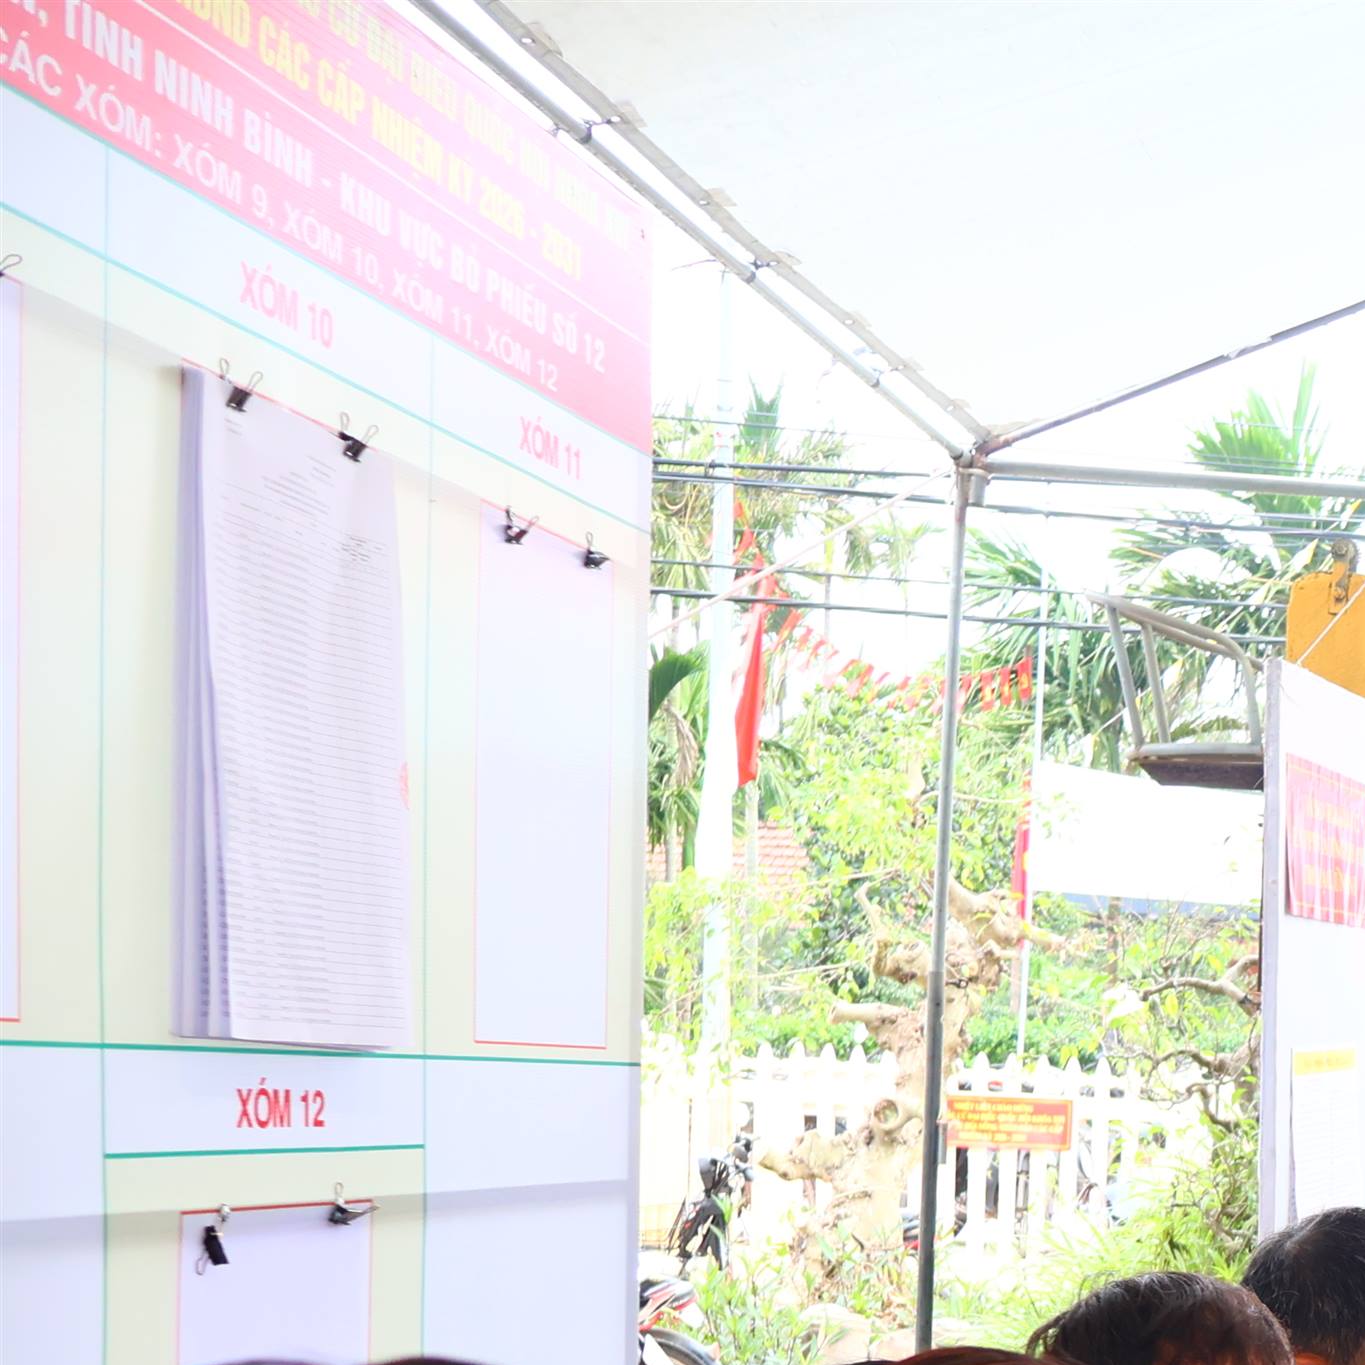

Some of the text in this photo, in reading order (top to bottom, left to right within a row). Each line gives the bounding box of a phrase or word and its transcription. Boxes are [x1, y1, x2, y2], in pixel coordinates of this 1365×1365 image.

[258, 15, 310, 91] CÁC
[317, 57, 365, 125] CẤP
[74, 73, 163, 159] XÓM:
[172, 133, 241, 205] XÓM
[252, 183, 274, 228] 9,
[282, 200, 343, 265] XÓM
[392, 267, 444, 324] XÓM
[485, 323, 531, 376] XÓM
[536, 358, 558, 393] 12
[154, 49, 233, 139] NINH
[244, 107, 313, 189] BÌNH
[340, 170, 391, 237] KHU
[399, 207, 444, 271] VỰC
[486, 267, 547, 336] PHIẾU
[552, 311, 577, 355] SỐ
[583, 331, 606, 375] 12
[240, 260, 333, 349] XÓM 10
[519, 415, 581, 480] XÓM 11
[236, 1077, 326, 1128] XÓM 12
